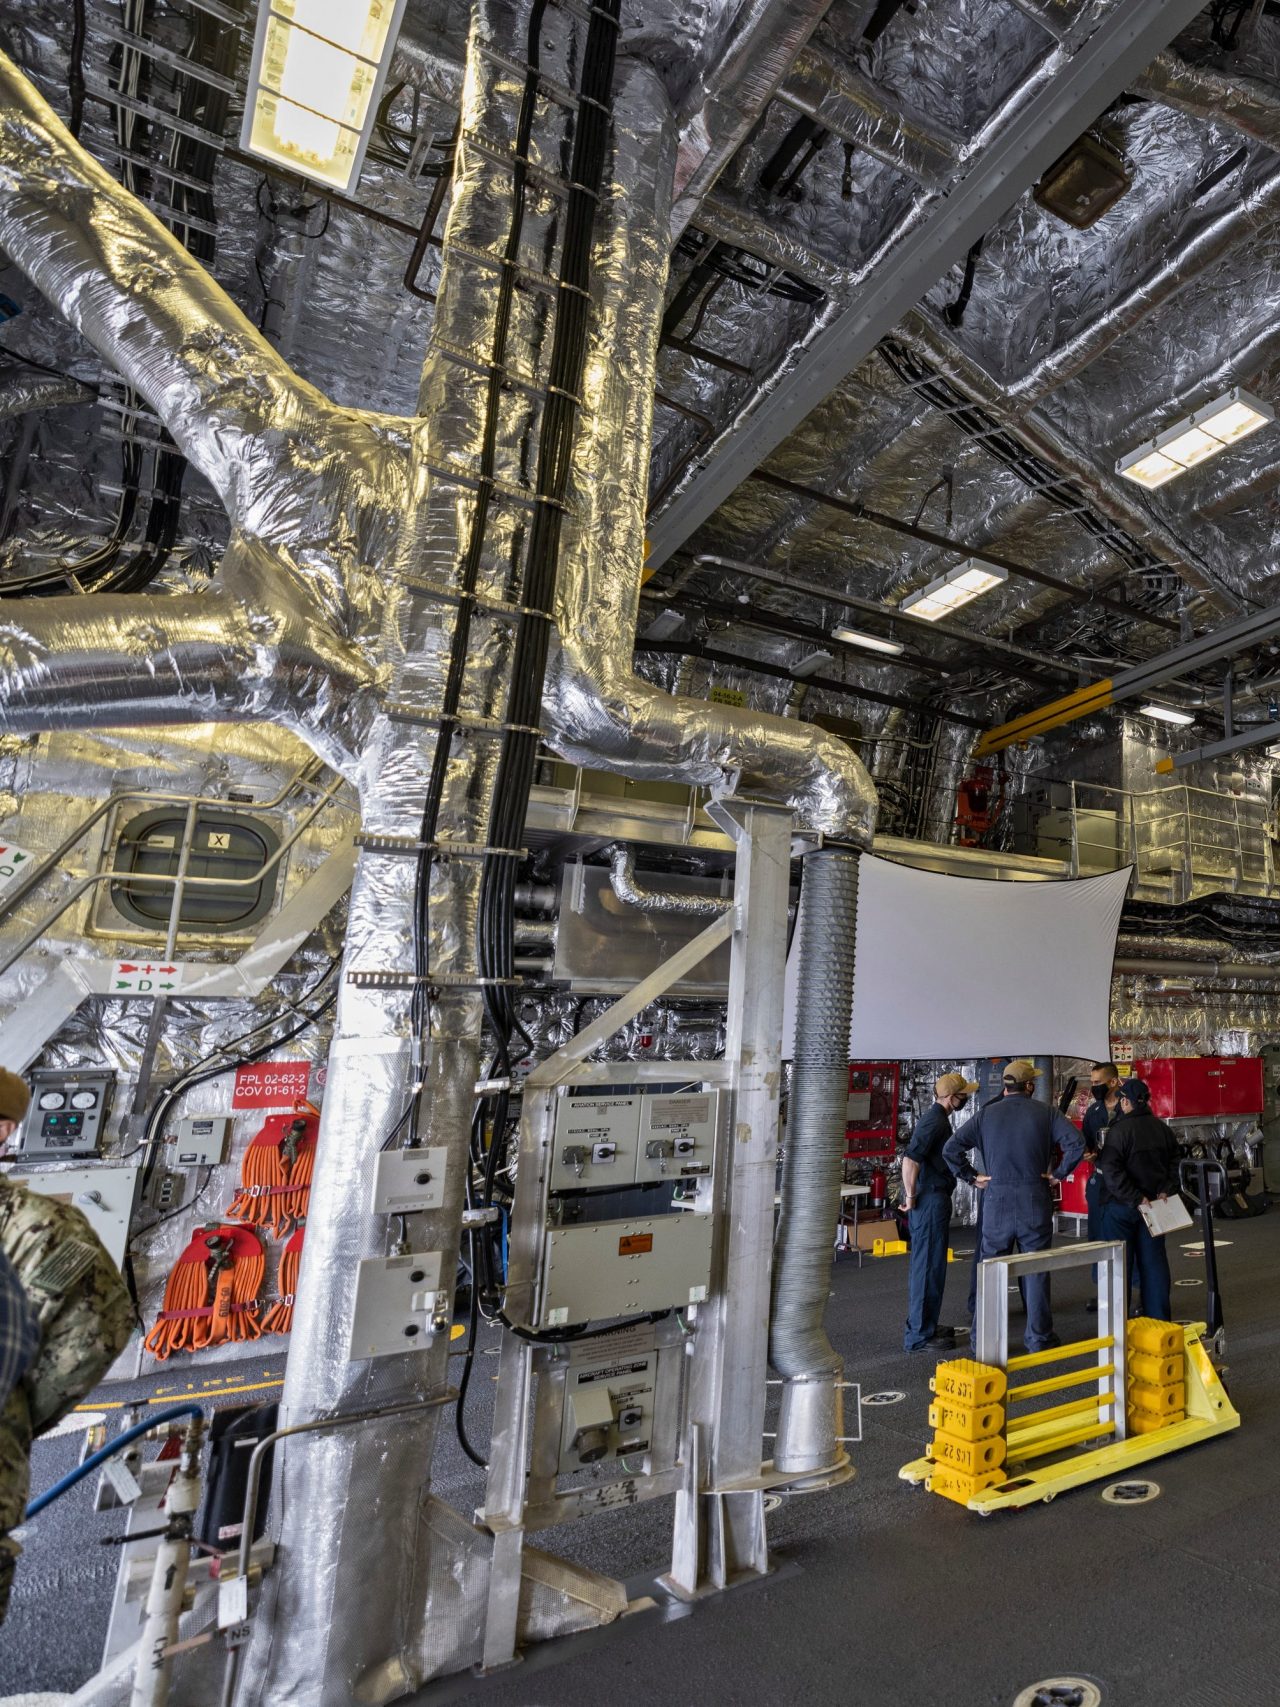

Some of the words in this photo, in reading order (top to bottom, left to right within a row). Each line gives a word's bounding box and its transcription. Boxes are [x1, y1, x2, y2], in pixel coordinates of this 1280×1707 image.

[214, 835, 224, 846] X
[138, 981, 153, 991] D
[239, 1075, 261, 1085] FPL
[264, 1074, 306, 1084] 02-62-2
[235, 1086, 262, 1096] COV
[265, 1085, 306, 1095] 01-61-2
[944, 1377, 955, 1394] 22
[944, 1442, 954, 1460] 22
[230, 1625, 251, 1641] NS
